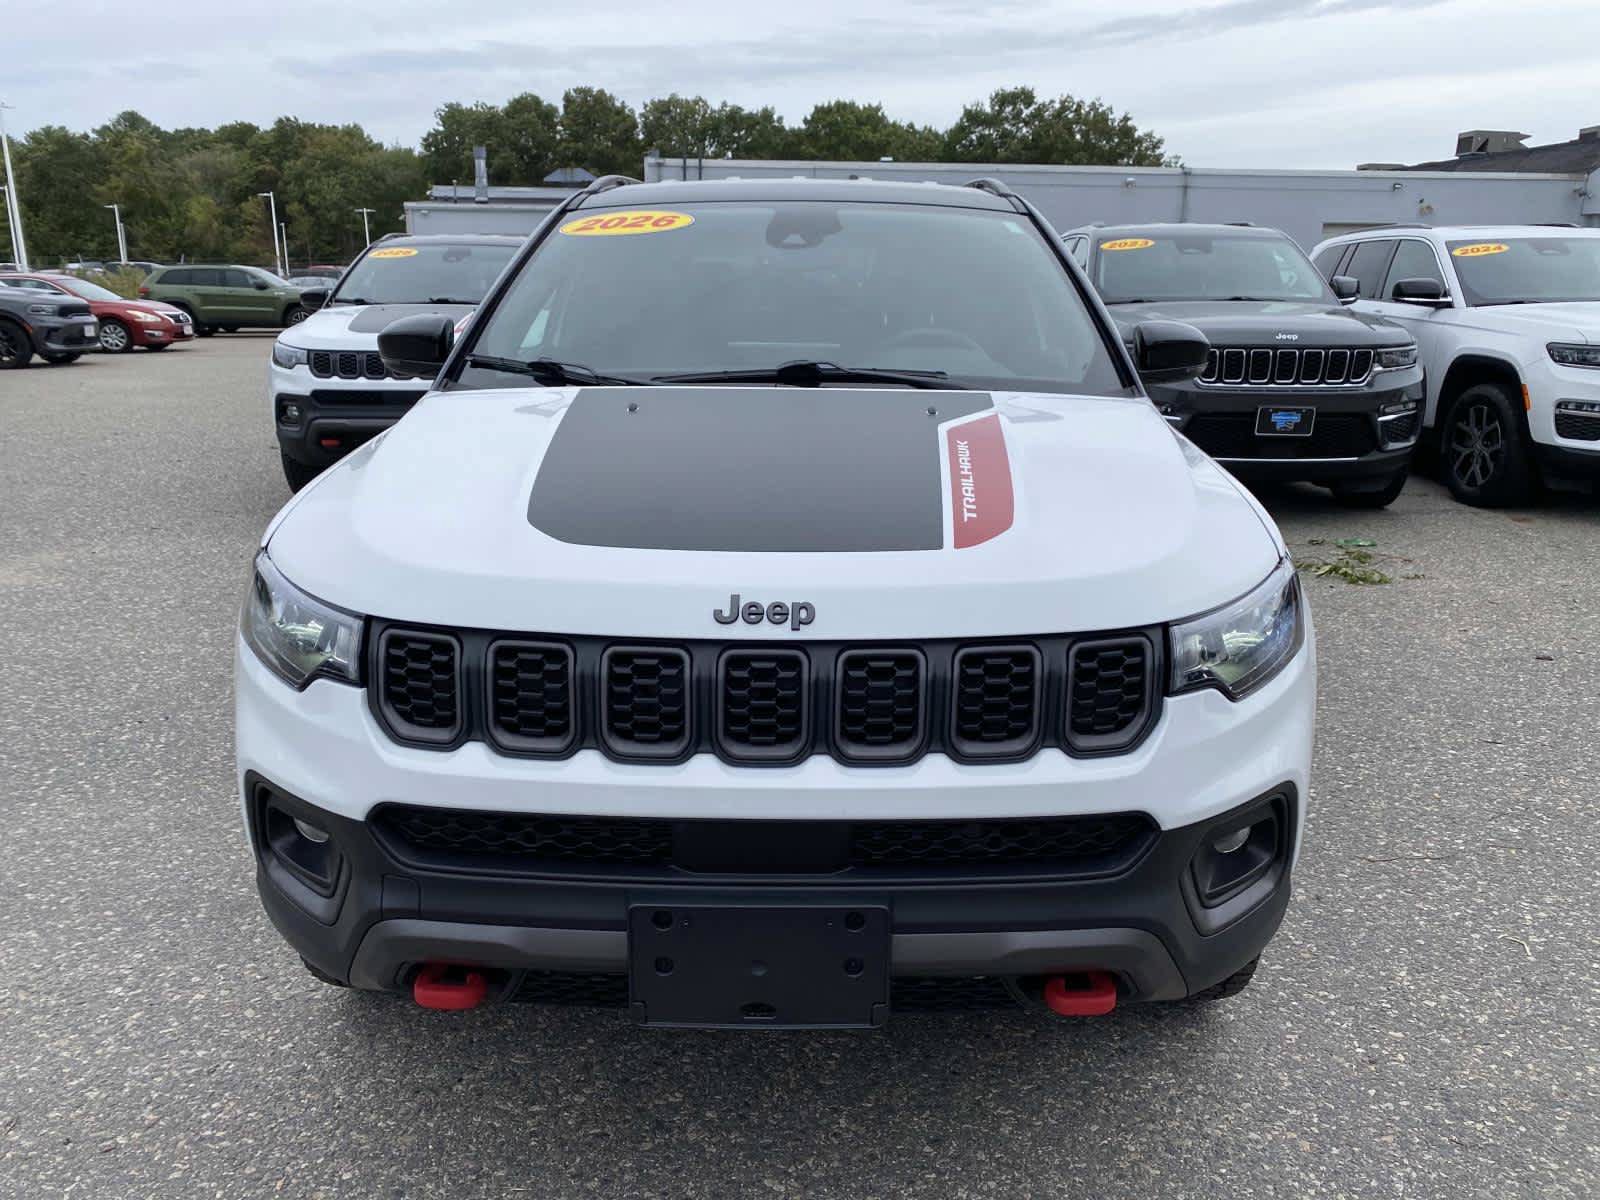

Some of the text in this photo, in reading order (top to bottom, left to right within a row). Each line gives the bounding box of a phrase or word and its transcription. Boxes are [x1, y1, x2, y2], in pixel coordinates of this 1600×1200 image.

[573, 215, 681, 233] 2026
[1459, 244, 1504, 255] 2024
[1275, 332, 1298, 341] Jeep
[956, 440, 977, 522] TRAILHAWK
[713, 594, 816, 631] Jeep
